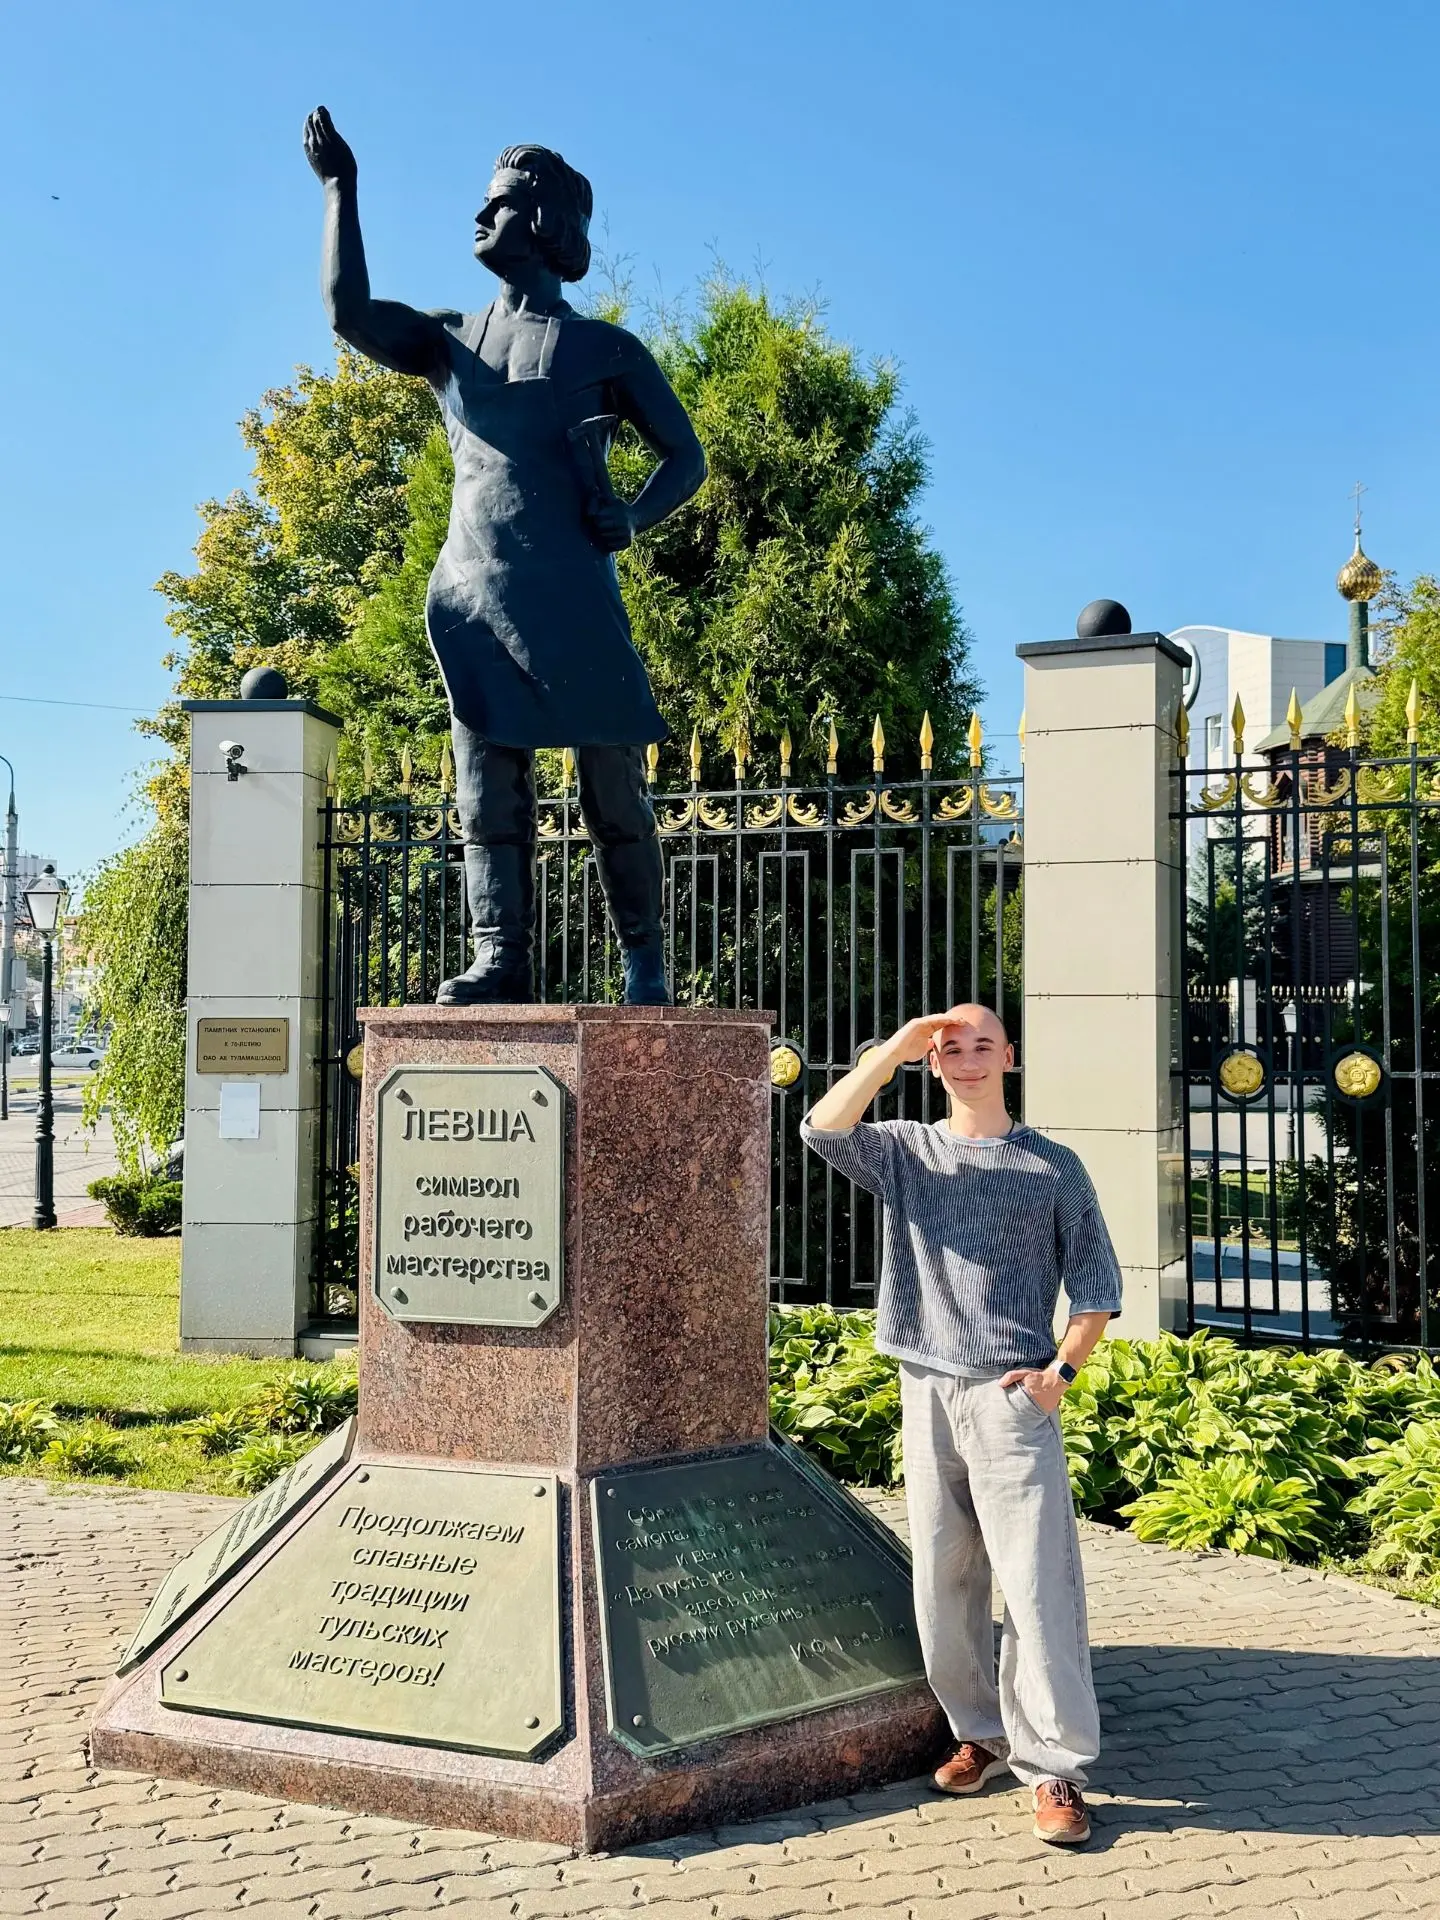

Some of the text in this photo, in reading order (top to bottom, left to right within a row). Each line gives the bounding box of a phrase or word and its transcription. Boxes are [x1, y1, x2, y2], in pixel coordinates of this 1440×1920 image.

[401, 1107, 536, 1143] ЛЕВША
[415, 1175, 520, 1198] символ
[404, 1209, 533, 1242] рабочего
[386, 1253, 550, 1284] мастерства
[338, 1505, 525, 1544] Продолжаем
[352, 1544, 477, 1575] славные
[330, 1578, 470, 1613] традиции
[655, 1573, 709, 1600] пусть
[711, 1567, 735, 1585] на
[685, 1596, 739, 1618] здесь
[318, 1612, 449, 1650] тульских
[647, 1624, 724, 1658] русский
[288, 1649, 445, 1688] мастеров!
